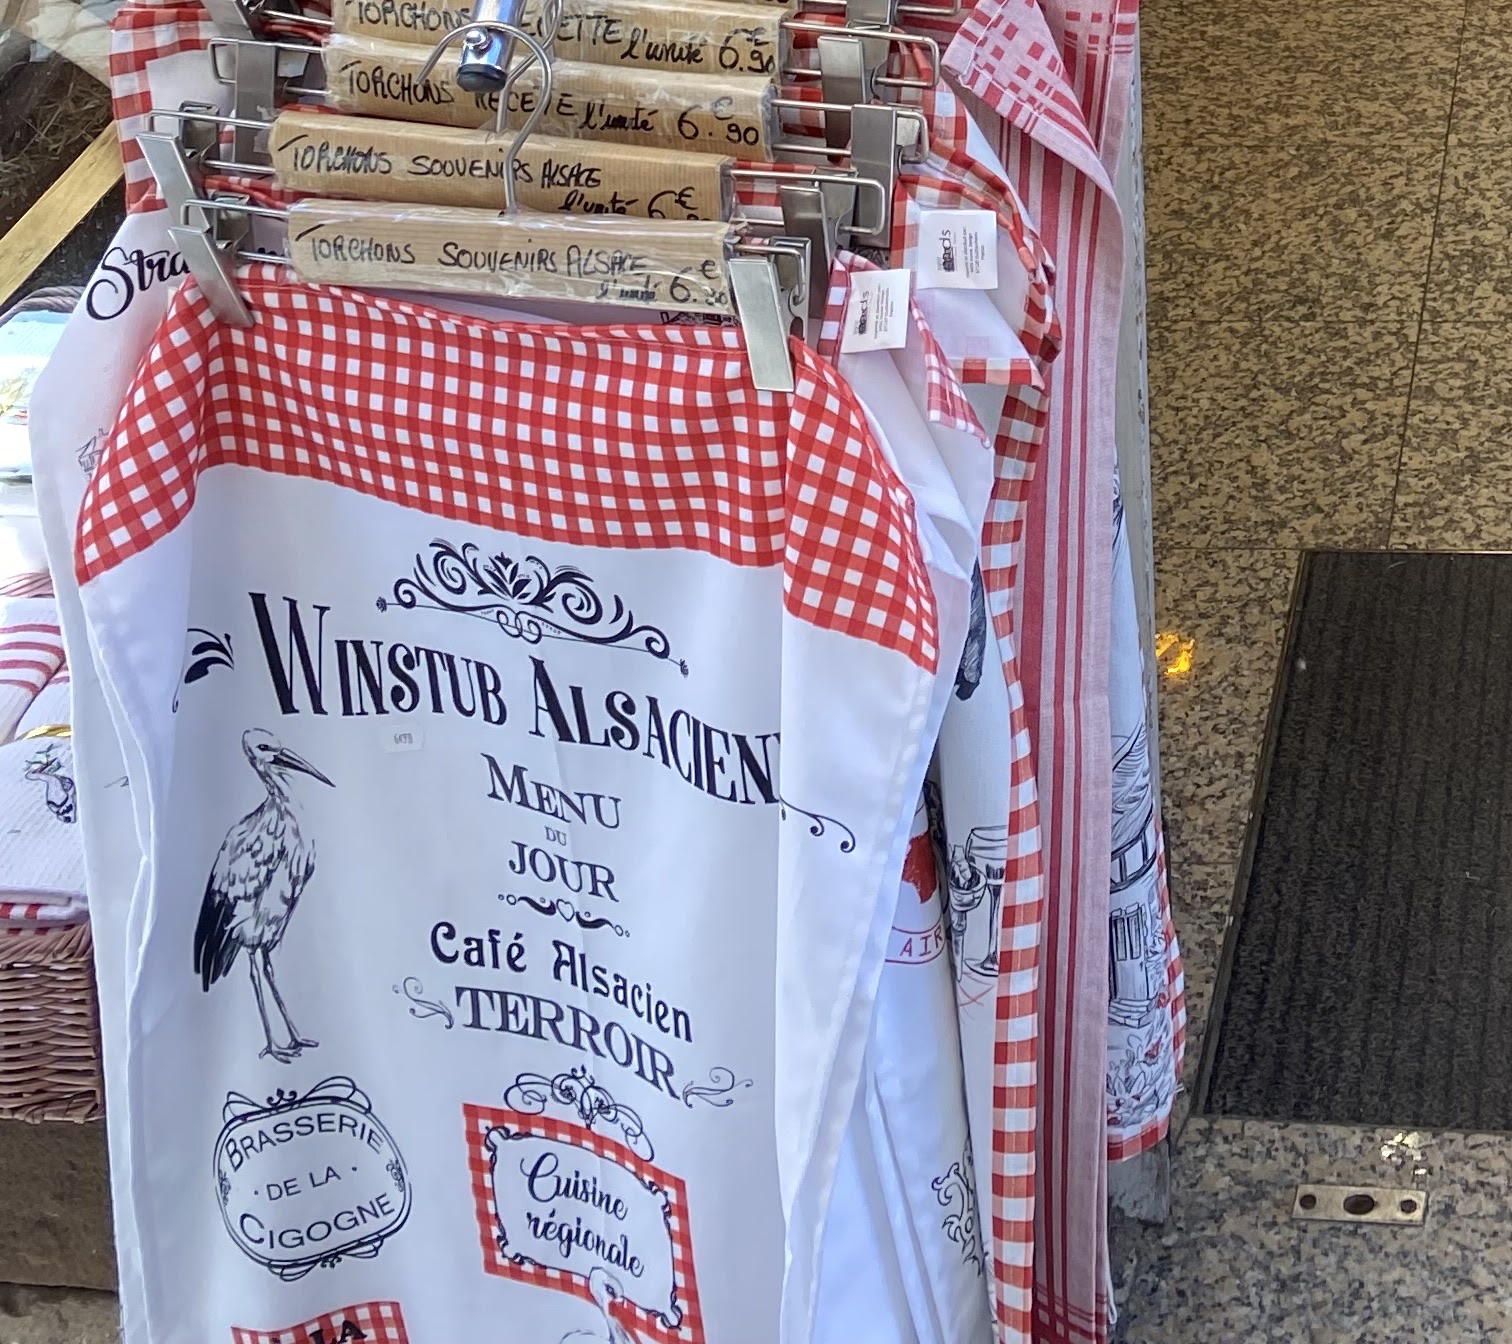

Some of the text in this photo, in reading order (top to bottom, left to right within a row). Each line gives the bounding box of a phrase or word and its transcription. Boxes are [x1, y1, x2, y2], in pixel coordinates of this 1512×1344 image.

[620, 26, 705, 64] l'unité
[337, 59, 455, 105] TORCHONS
[578, 96, 659, 131] l'unité
[277, 133, 602, 190] TORCHONS SOUVENIRS ALSACE
[294, 222, 648, 277] TORCHONS SOUVENIRS ALSACE
[247, 590, 781, 806] WINSTUB ALSACIEN
[480, 751, 623, 831] MENU
[544, 825, 568, 847] DU
[508, 839, 621, 903] JOUR
[430, 920, 694, 1044] Café Alsacien
[454, 985, 682, 1101] TERROIR
[224, 1112, 385, 1173] BRASSERIE
[266, 1165, 342, 1202] DE LA
[518, 1151, 629, 1221] Cuisine
[238, 1192, 396, 1250] CIGOGNE
[525, 1208, 645, 1279] régionale
